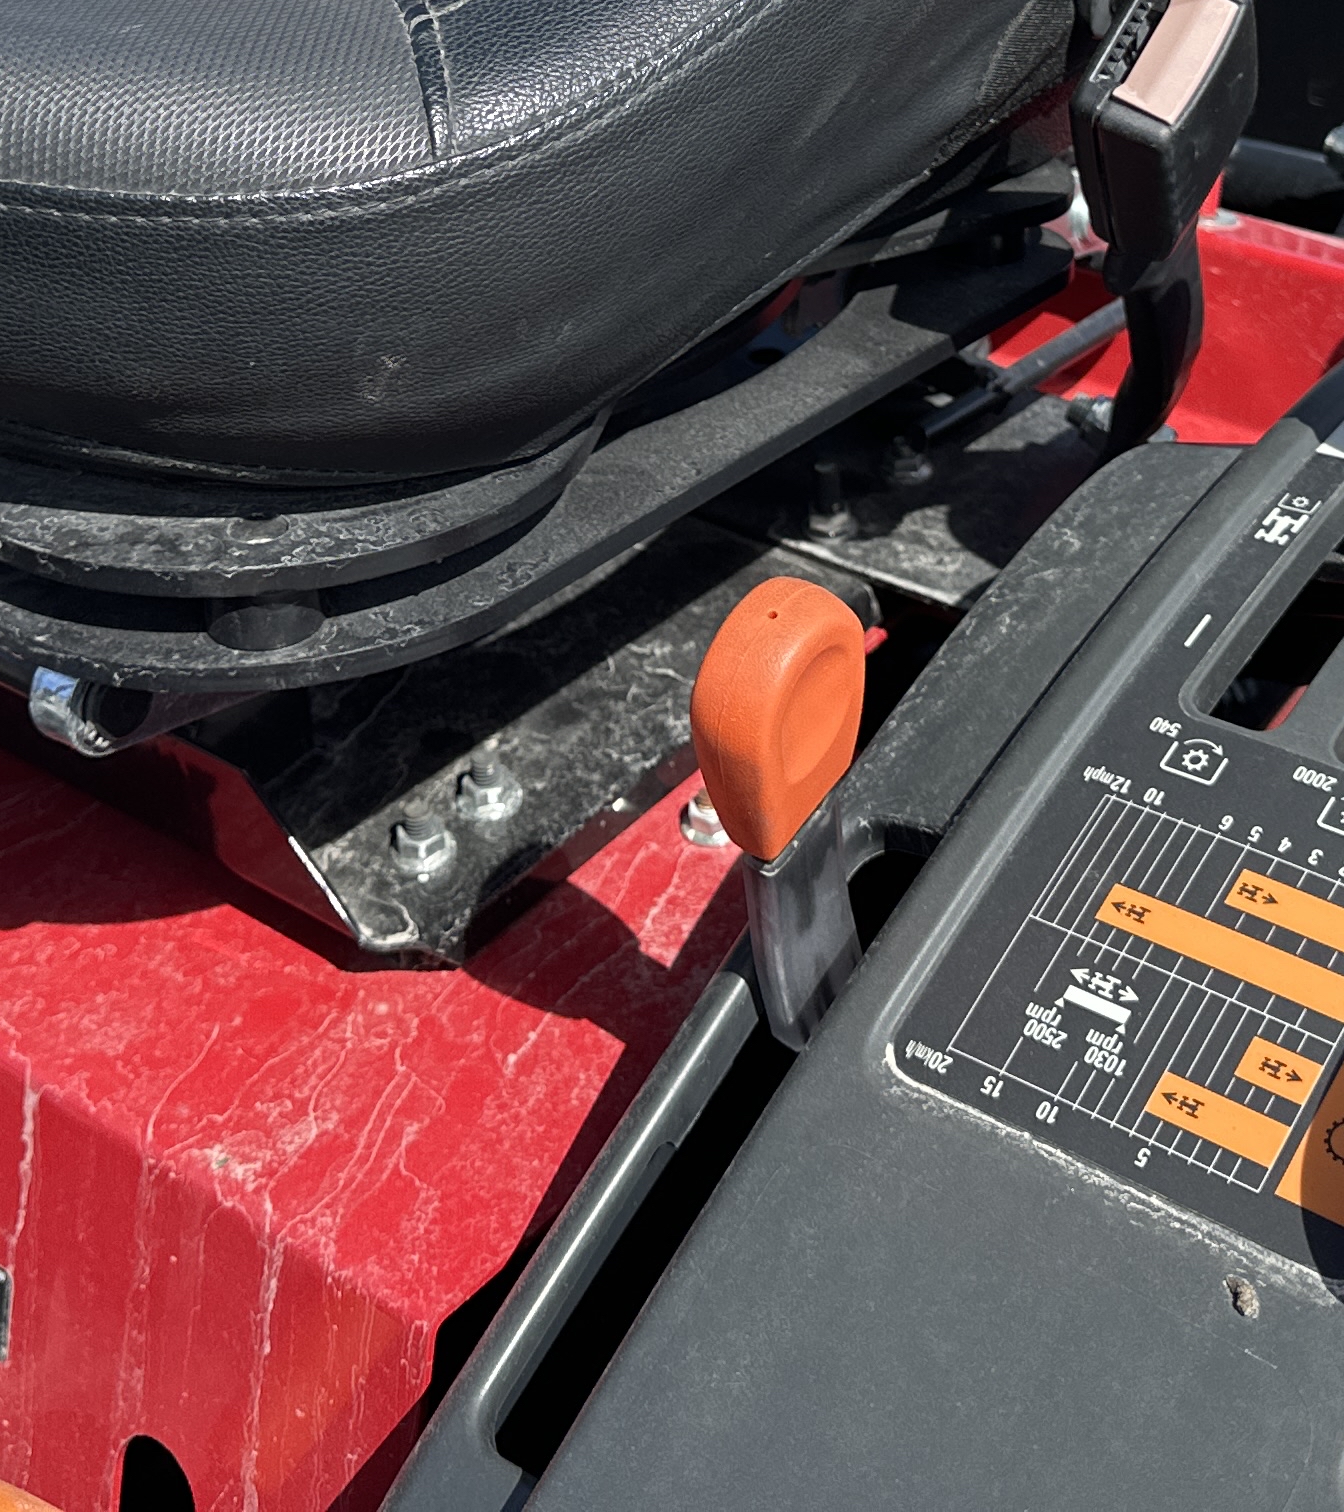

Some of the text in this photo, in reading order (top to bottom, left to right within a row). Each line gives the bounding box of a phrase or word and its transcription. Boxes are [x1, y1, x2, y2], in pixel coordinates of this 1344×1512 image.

[1149, 717, 1182, 738] 540
[1293, 766, 1338, 792] 2000
[1143, 787, 1166, 806] 10
[1218, 814, 1234, 831] 6
[1248, 826, 1264, 843] 5
[1277, 837, 1293, 853] 4
[1307, 849, 1323, 865] 3
[1025, 1002, 1063, 1027] rpm
[1023, 1018, 1068, 1050] 2500
[1085, 1028, 1124, 1054] rpm
[1084, 1046, 1127, 1077] 1030
[905, 1039, 1151, 1168] 5 10 15 20km/h
